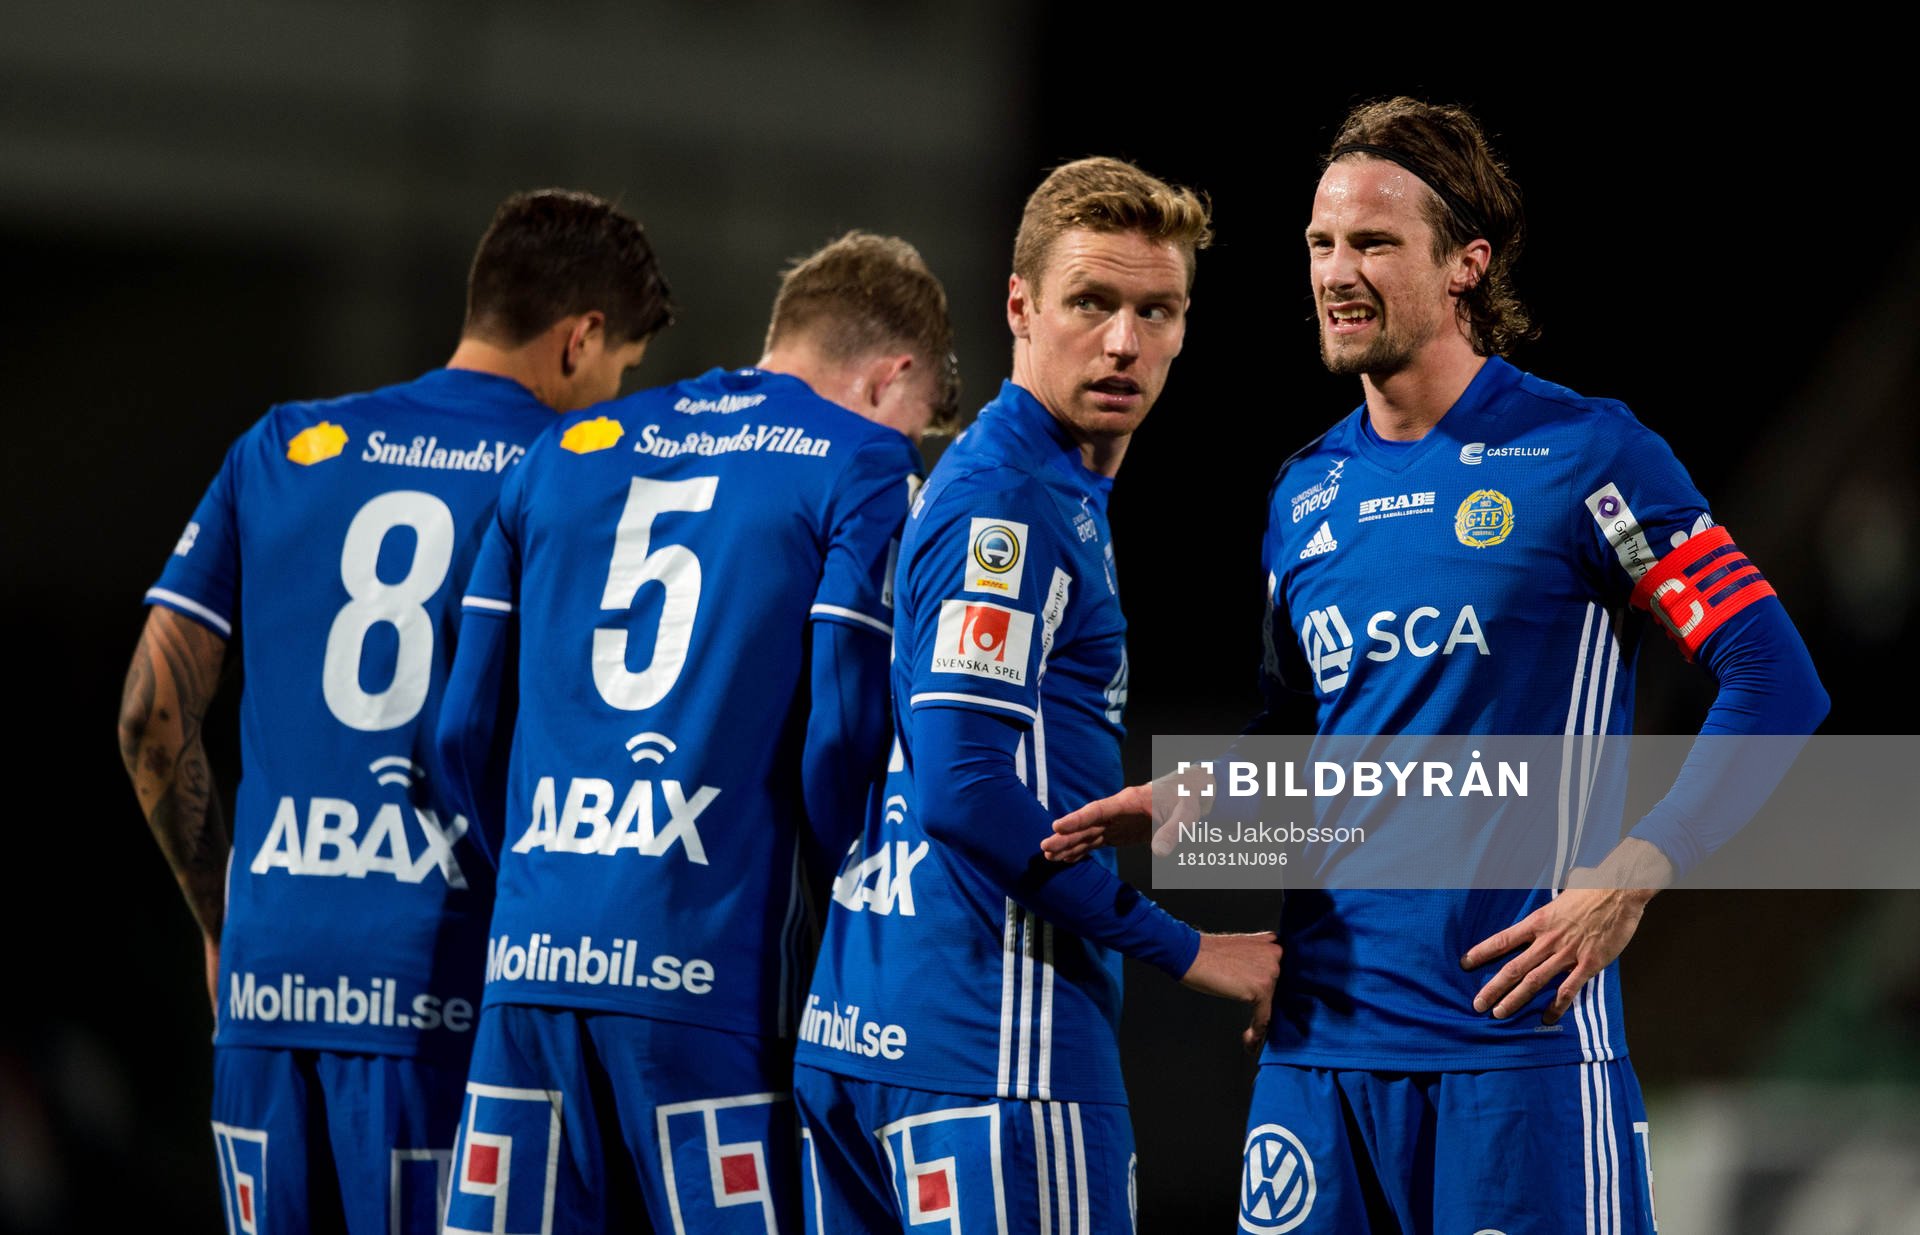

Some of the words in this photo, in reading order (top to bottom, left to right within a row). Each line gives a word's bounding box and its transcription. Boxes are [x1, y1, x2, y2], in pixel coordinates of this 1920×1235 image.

[1487, 447, 1550, 457] CASTELLUM
[1366, 492, 1426, 514] PEAB
[1299, 540, 1338, 560] adidas
[322, 490, 455, 732] 8
[591, 475, 719, 712] 5
[1650, 578, 1704, 638] C
[1366, 604, 1491, 662] SCA
[936, 657, 989, 673] SVENSKA
[995, 665, 1021, 681] SPEL
[250, 796, 469, 889] ABAX
[512, 776, 722, 866] ABAX
[486, 933, 715, 995] Molinbil.se
[230, 972, 474, 1032] Molinbil.se
[798, 993, 907, 1060] linbil.se
